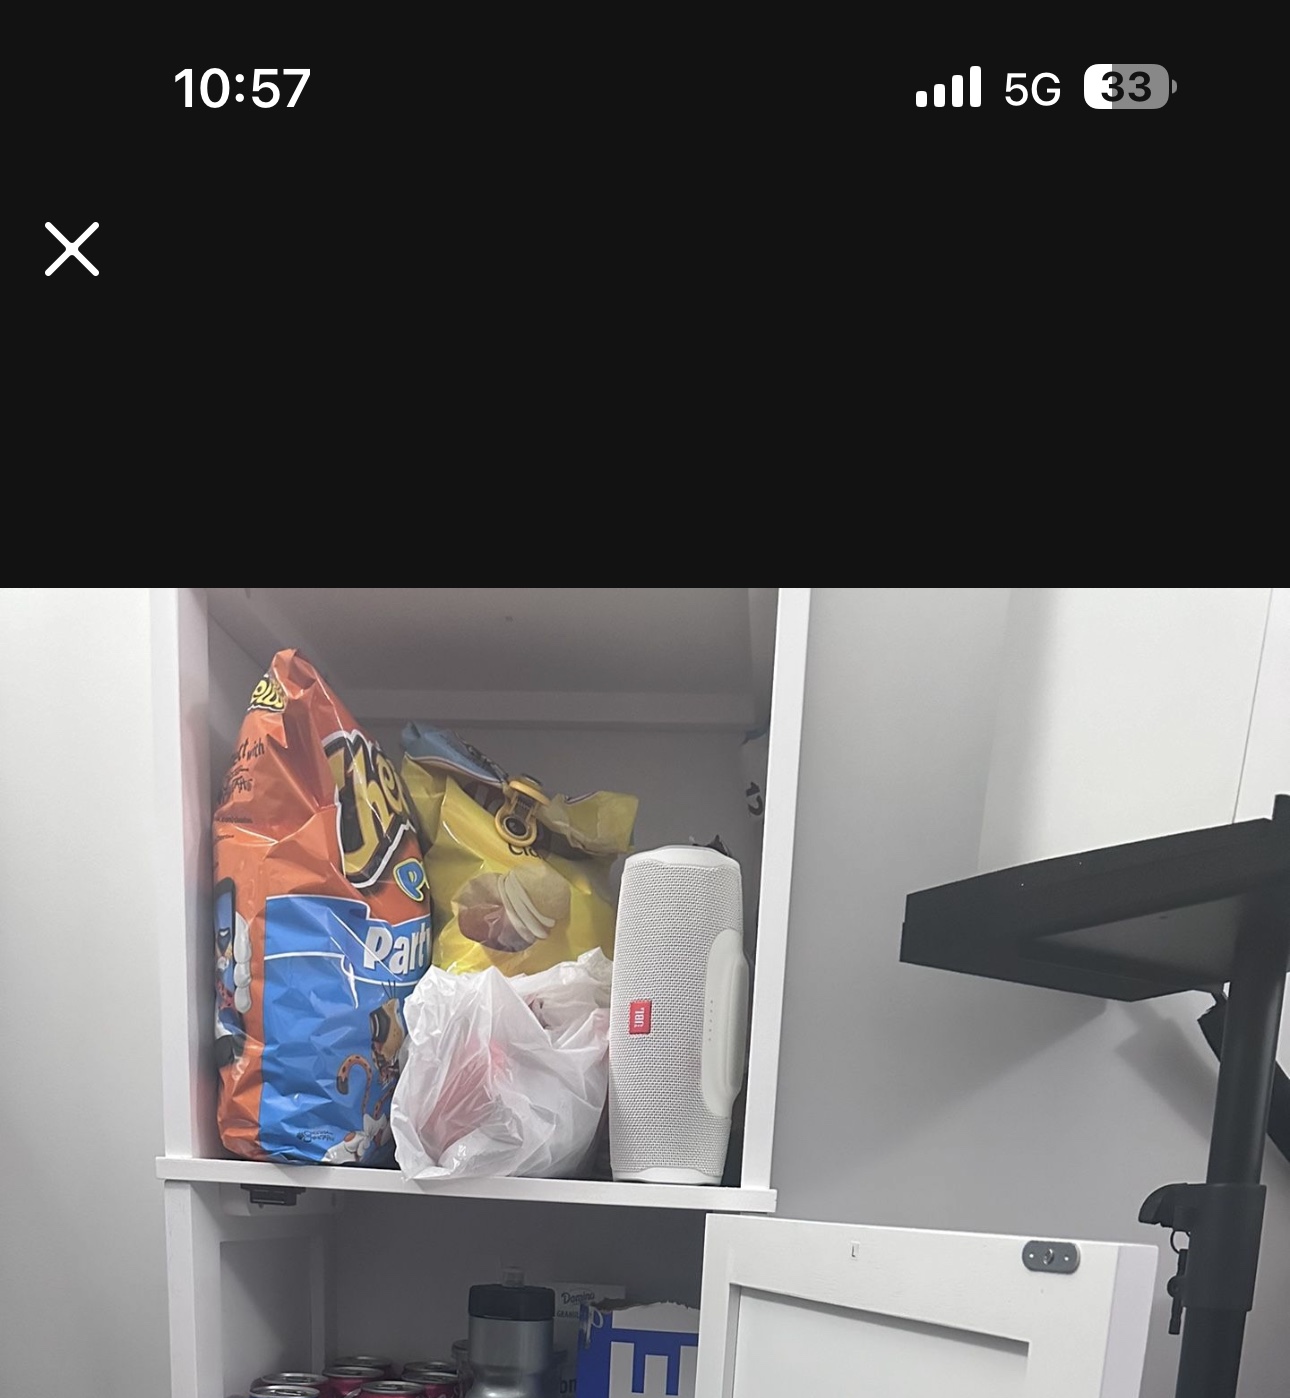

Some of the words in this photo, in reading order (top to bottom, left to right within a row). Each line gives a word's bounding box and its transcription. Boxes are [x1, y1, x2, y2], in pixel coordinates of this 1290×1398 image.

[363, 922, 431, 976] Part
[633, 1007, 645, 1029] JBL
[561, 1291, 595, 1304] Domino
